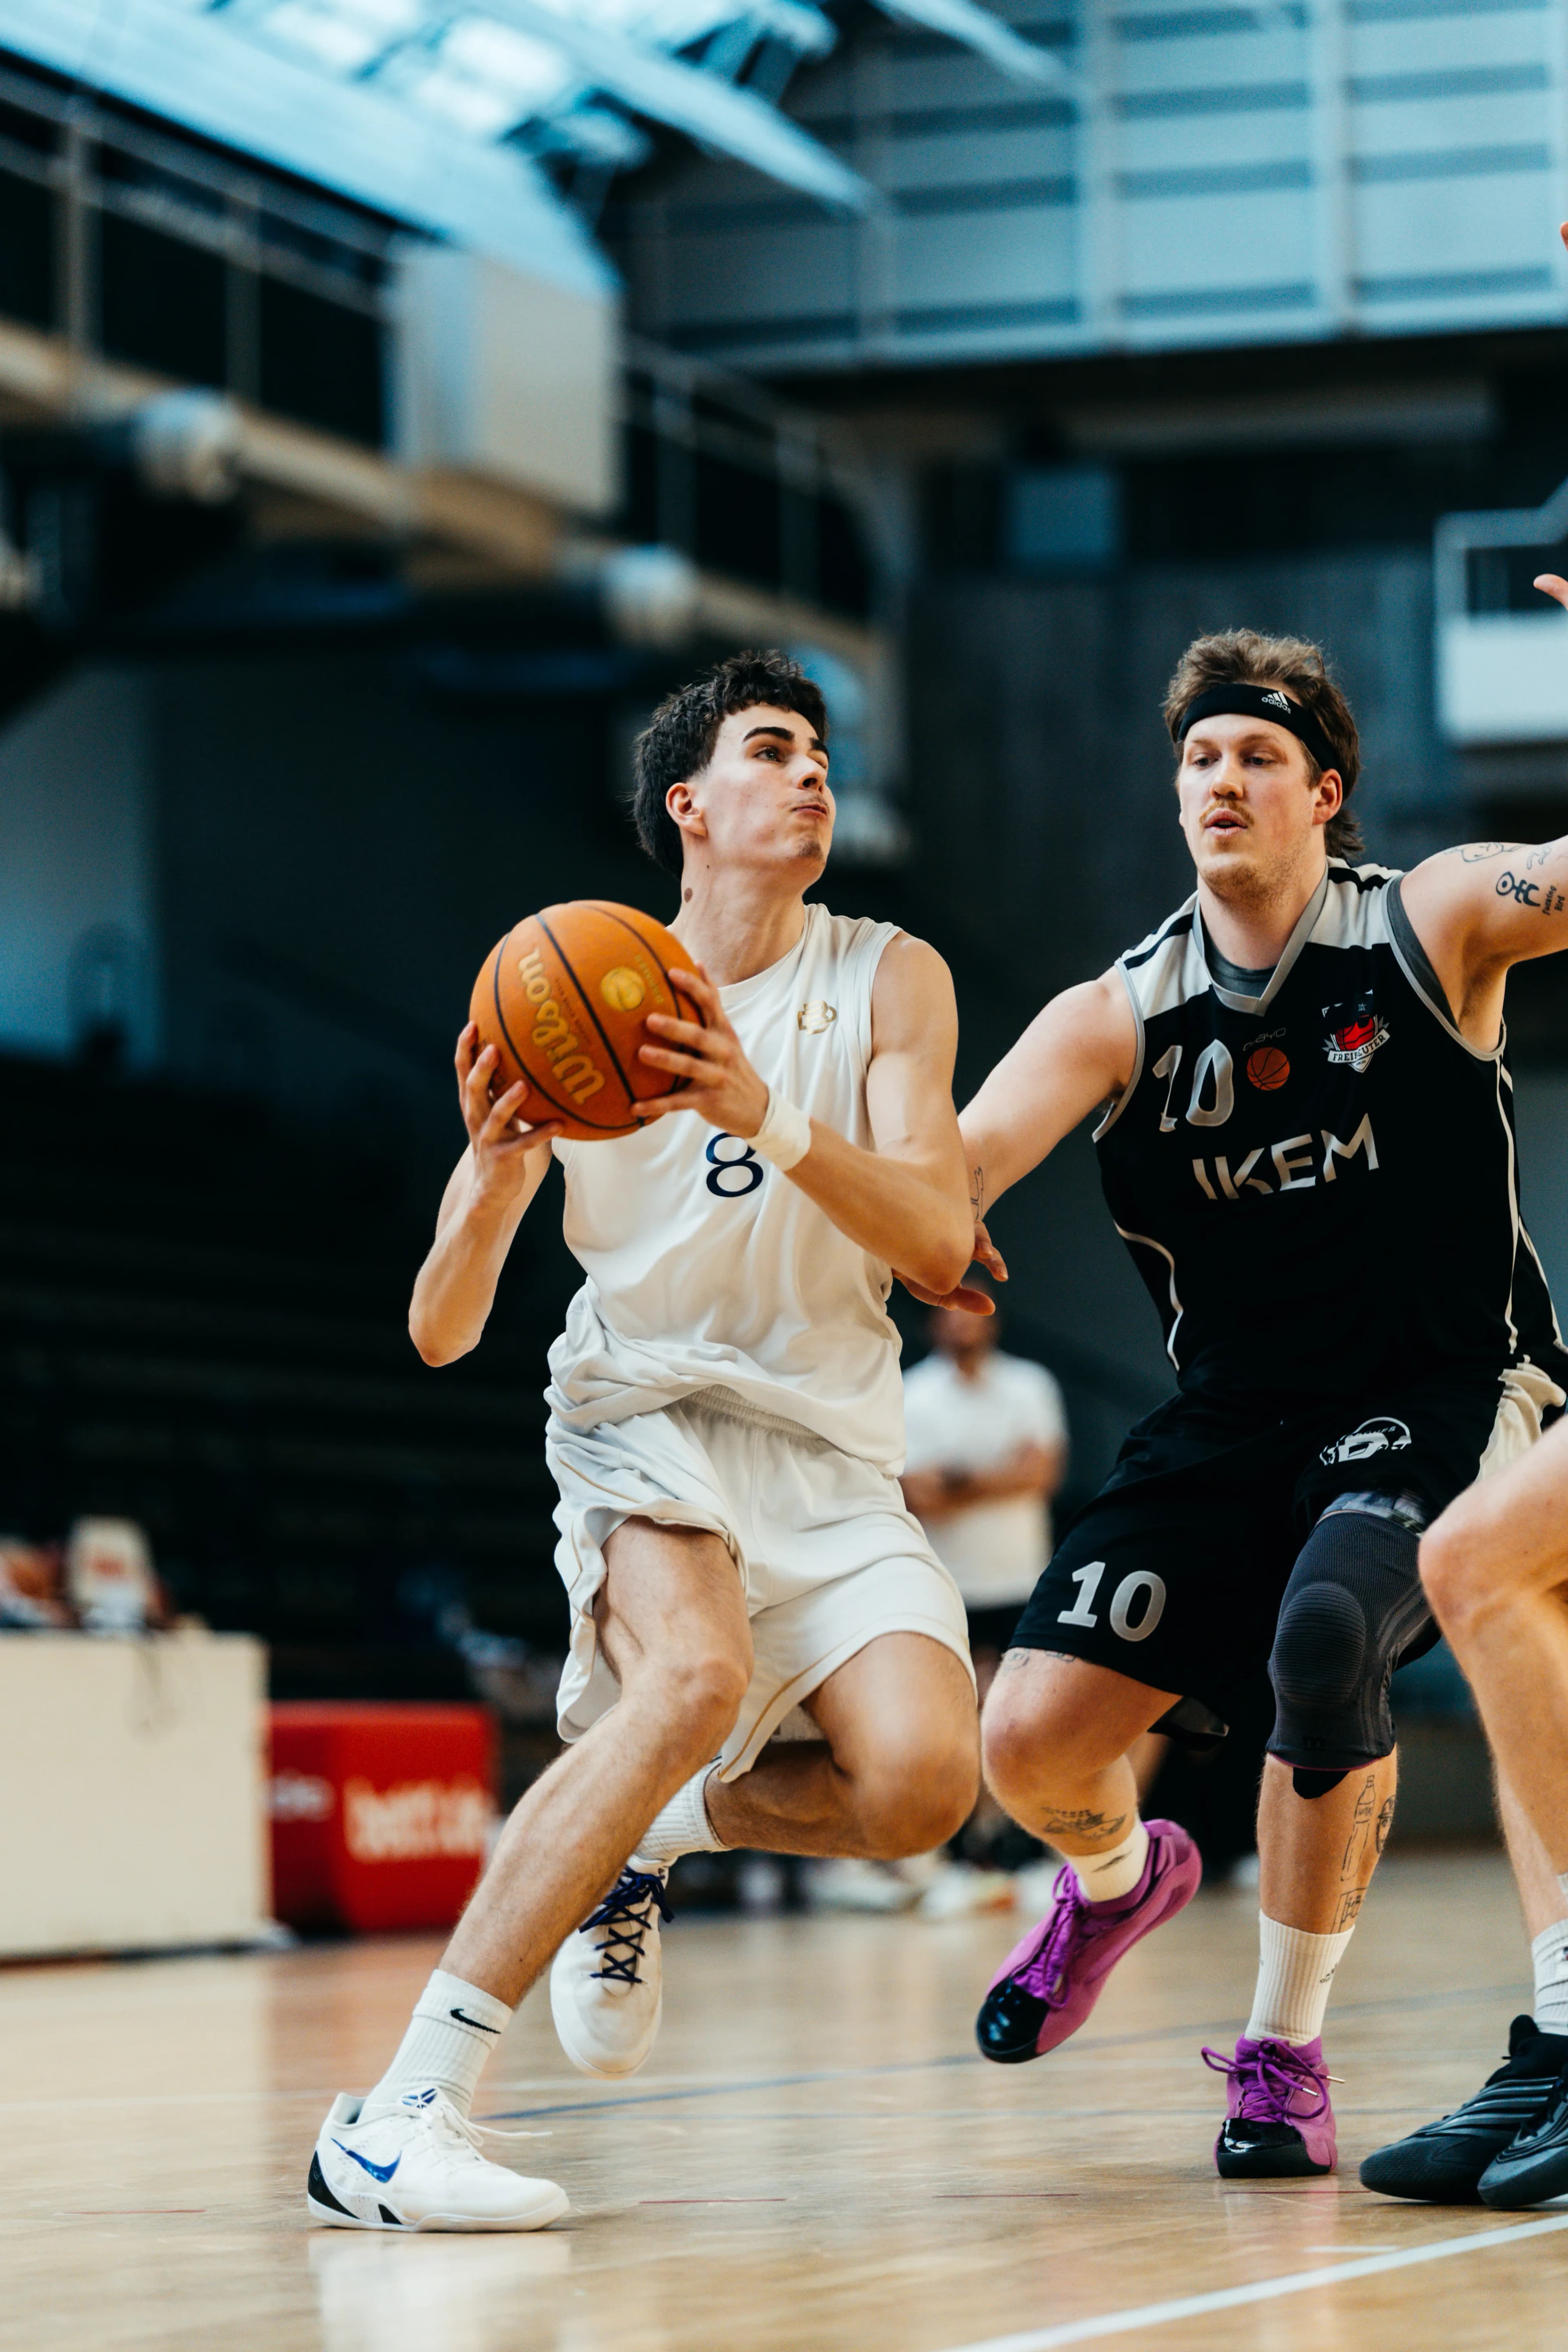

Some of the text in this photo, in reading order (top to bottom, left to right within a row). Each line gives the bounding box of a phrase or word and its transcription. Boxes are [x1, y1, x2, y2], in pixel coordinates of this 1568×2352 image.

[1262, 697, 1291, 714] adidas
[518, 949, 605, 1105] Wilson
[1152, 1039, 1234, 1132] 10
[706, 1132, 764, 1197] 8
[1192, 1113, 1379, 1200] IKEM
[1057, 1561, 1166, 1642] 10
